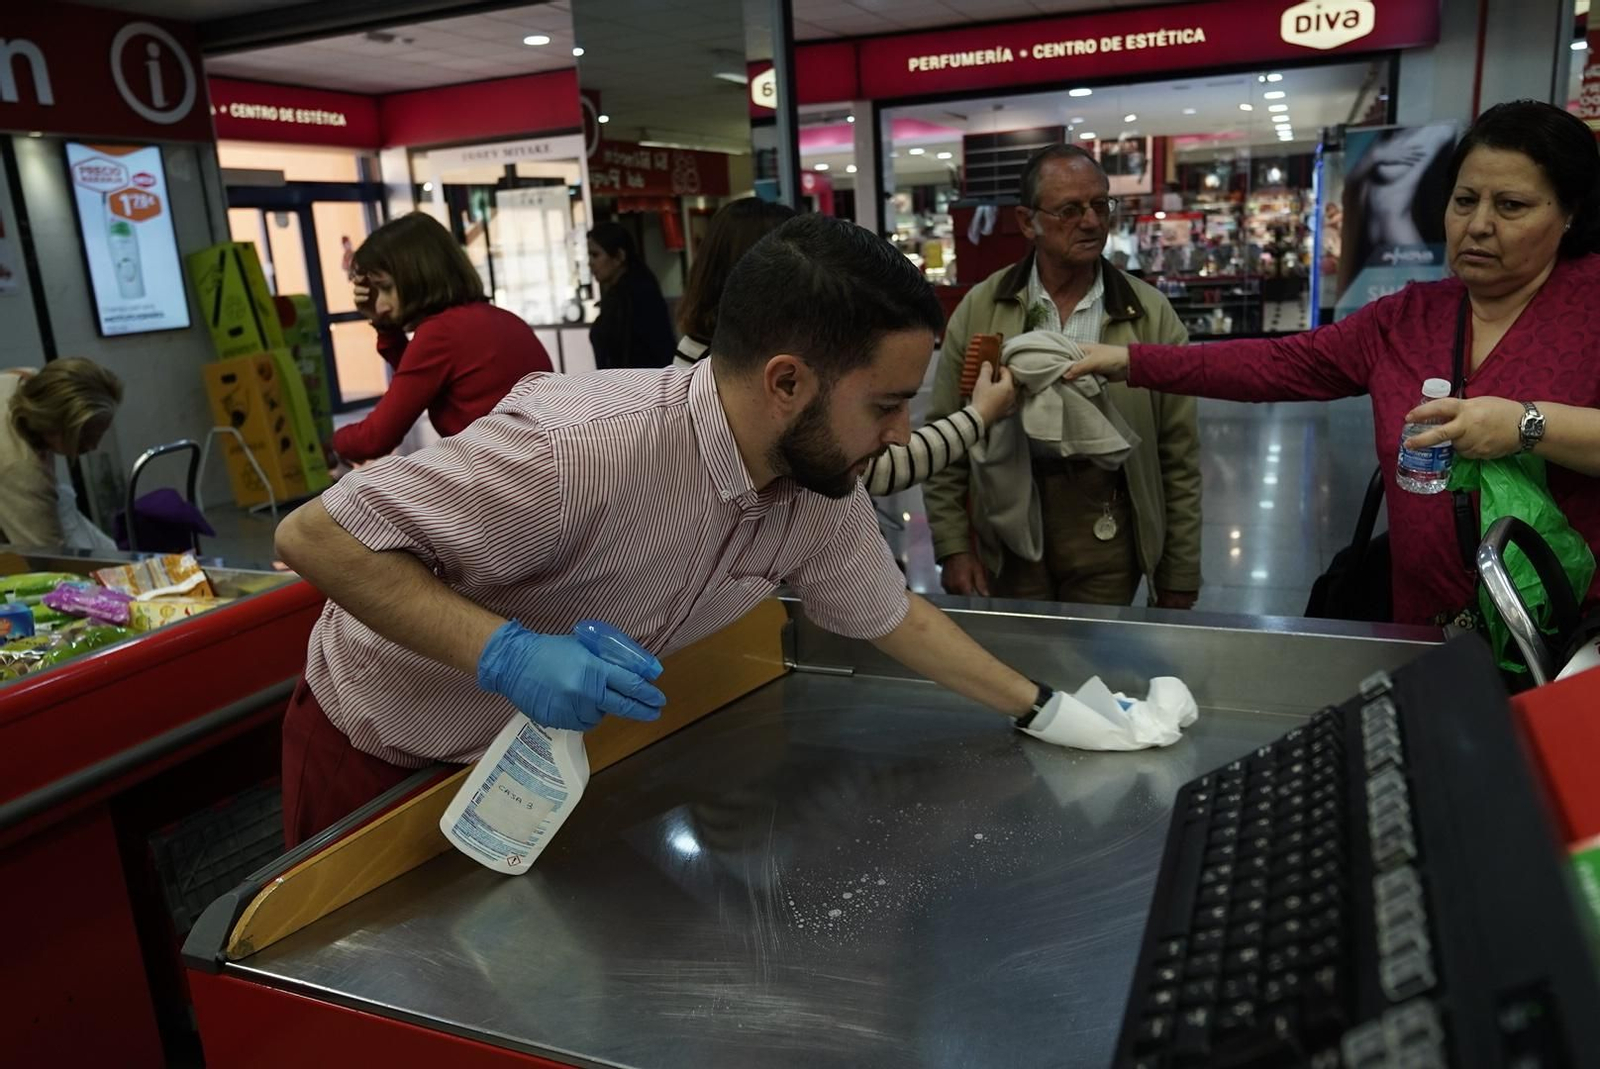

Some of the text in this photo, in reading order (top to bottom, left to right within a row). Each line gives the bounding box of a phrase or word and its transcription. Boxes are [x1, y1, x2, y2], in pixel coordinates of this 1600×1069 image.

[908, 27, 1206, 71] PERFUMERÍA CENTRO DE ESTÉTICA
[230, 103, 278, 121] CENTRO
[279, 107, 295, 122] DE
[295, 109, 347, 127] ESTÉTICA
